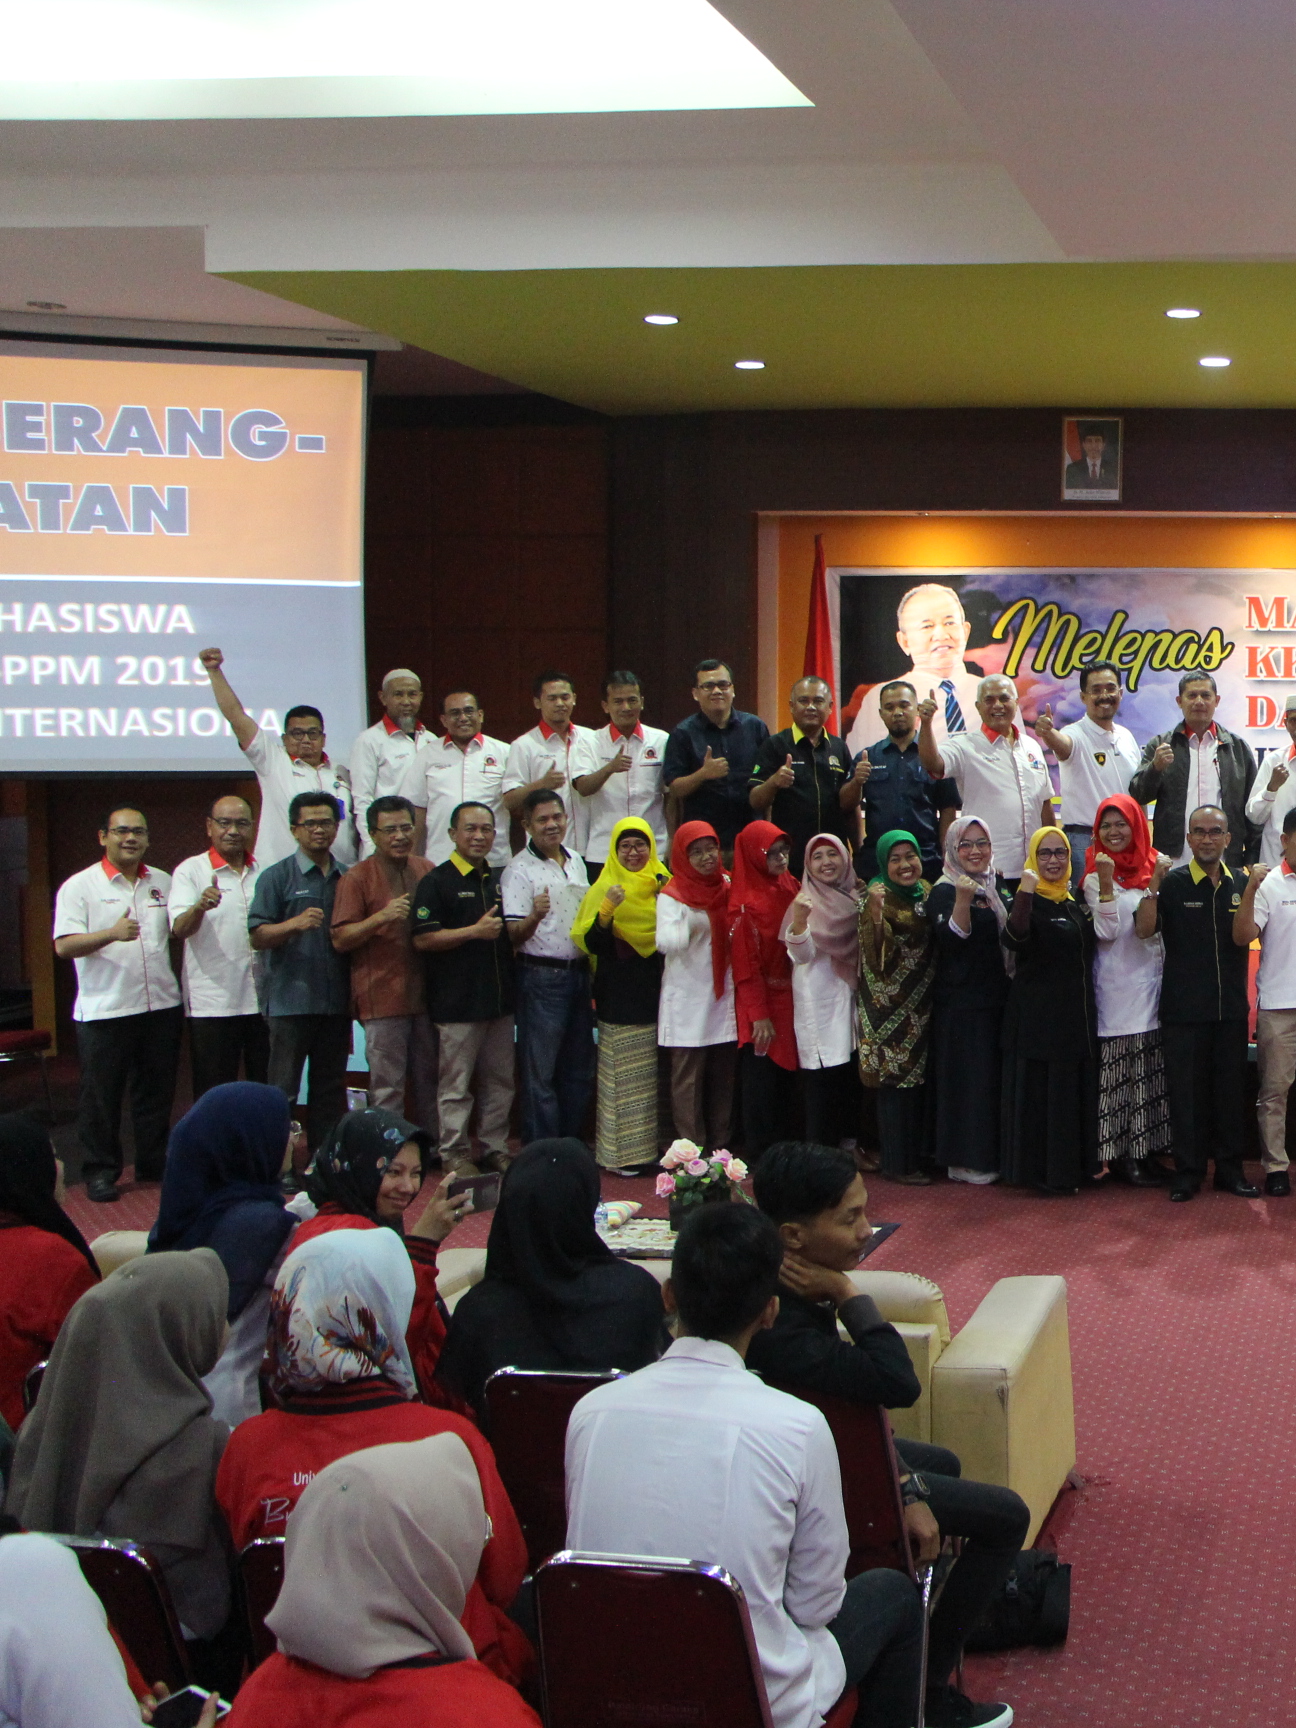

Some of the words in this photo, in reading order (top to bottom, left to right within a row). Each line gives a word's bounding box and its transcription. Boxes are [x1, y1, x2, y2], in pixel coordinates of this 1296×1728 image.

[2, 400, 326, 461] ERANG-
[0, 602, 195, 634] HASISWA
[990, 597, 1235, 692] Melepas
[0, 655, 101, 685] PPM
[0, 708, 284, 737] TERNASIOA
